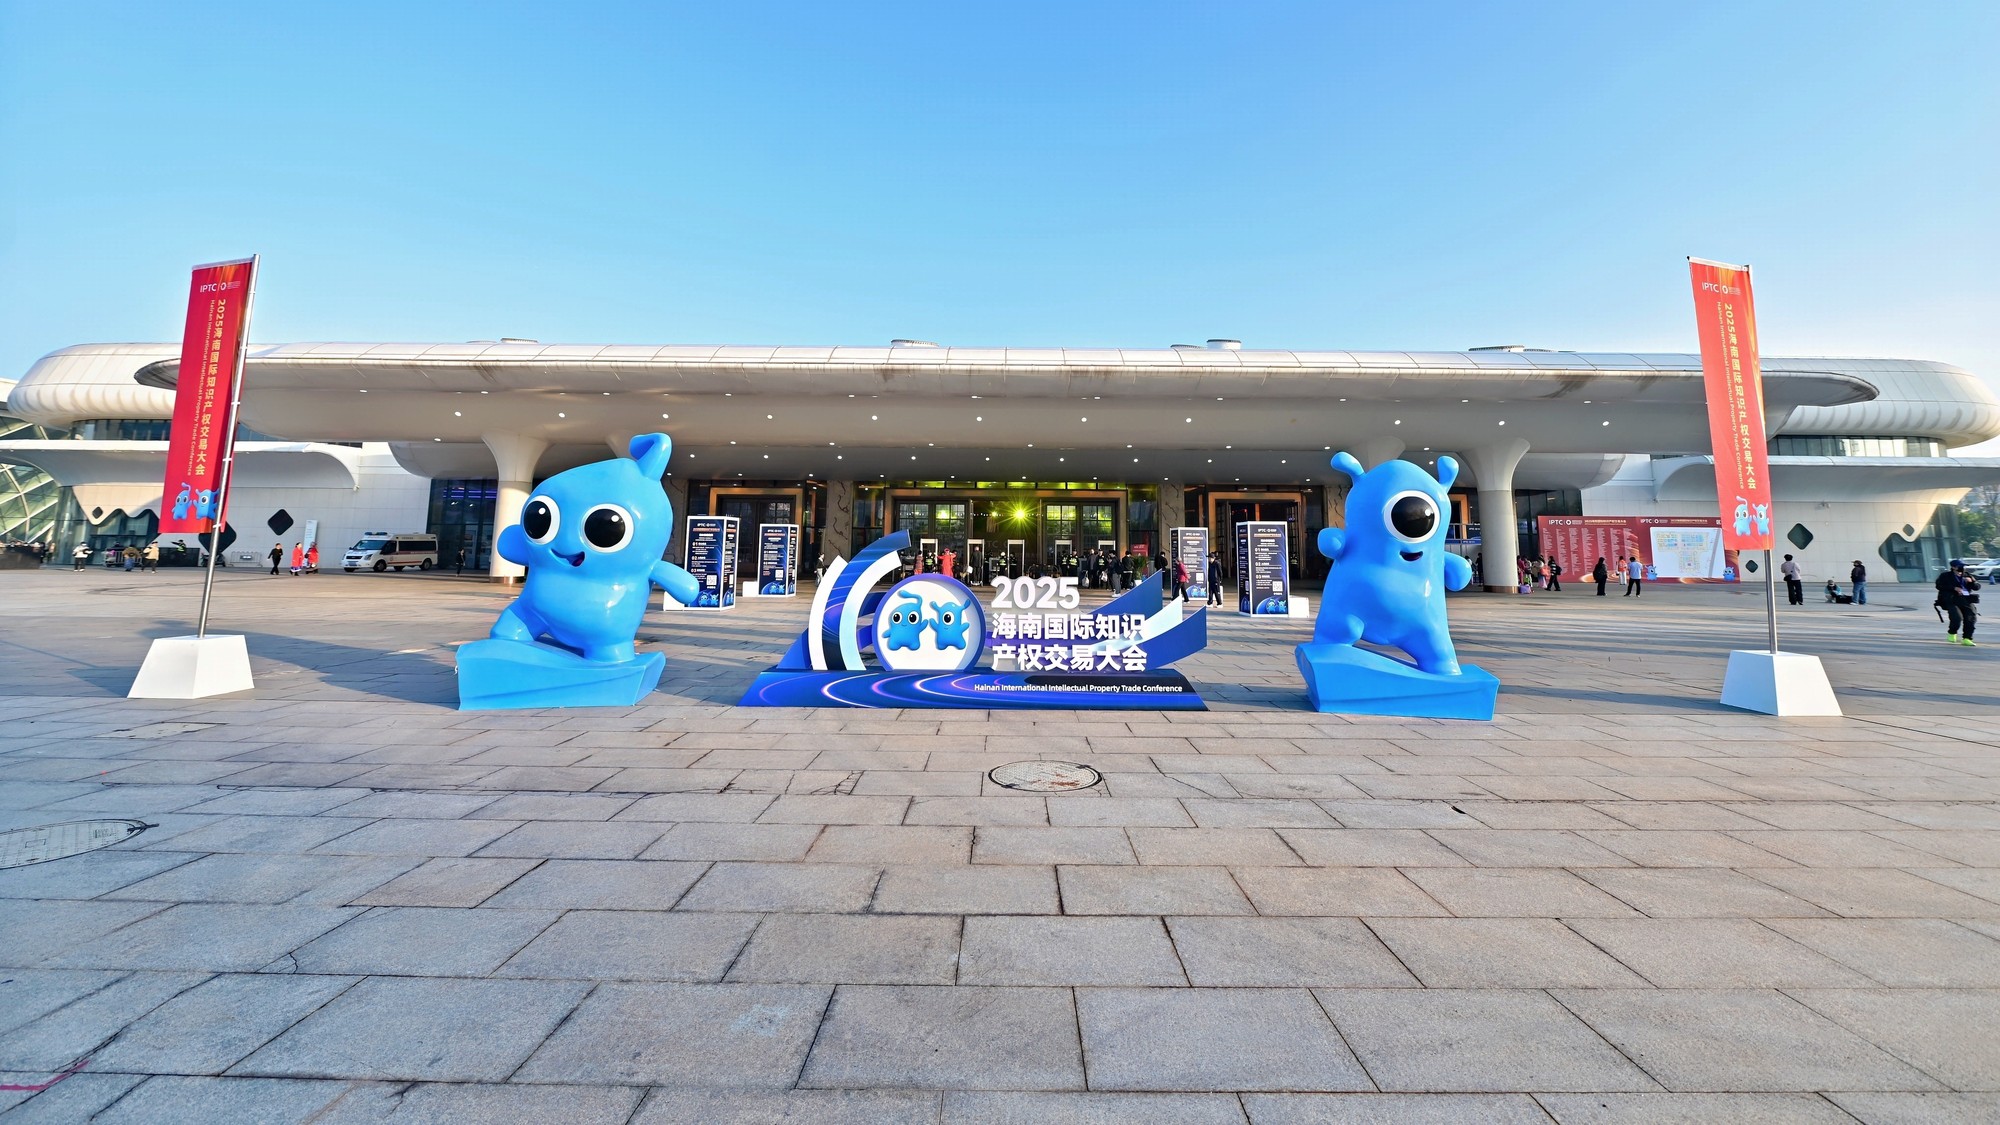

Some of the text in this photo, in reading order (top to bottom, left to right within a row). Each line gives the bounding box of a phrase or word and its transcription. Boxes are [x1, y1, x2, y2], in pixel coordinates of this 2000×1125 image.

[200, 283, 217, 293] IPTC
[1702, 281, 1719, 292] IPTC
[195, 299, 226, 476] 2025海南国际知识产权交易大会
[1724, 303, 1757, 489] 2025海南国际知识产权交易大会
[990, 575, 1081, 609] 2025
[991, 612, 1146, 640] 海南国际知识
[991, 643, 1148, 672] 产权交易大会
[974, 684, 1000, 692] Hainan
[1001, 684, 1048, 692] International
[1048, 684, 1089, 692] Intellectual
[1089, 684, 1120, 693] Property
